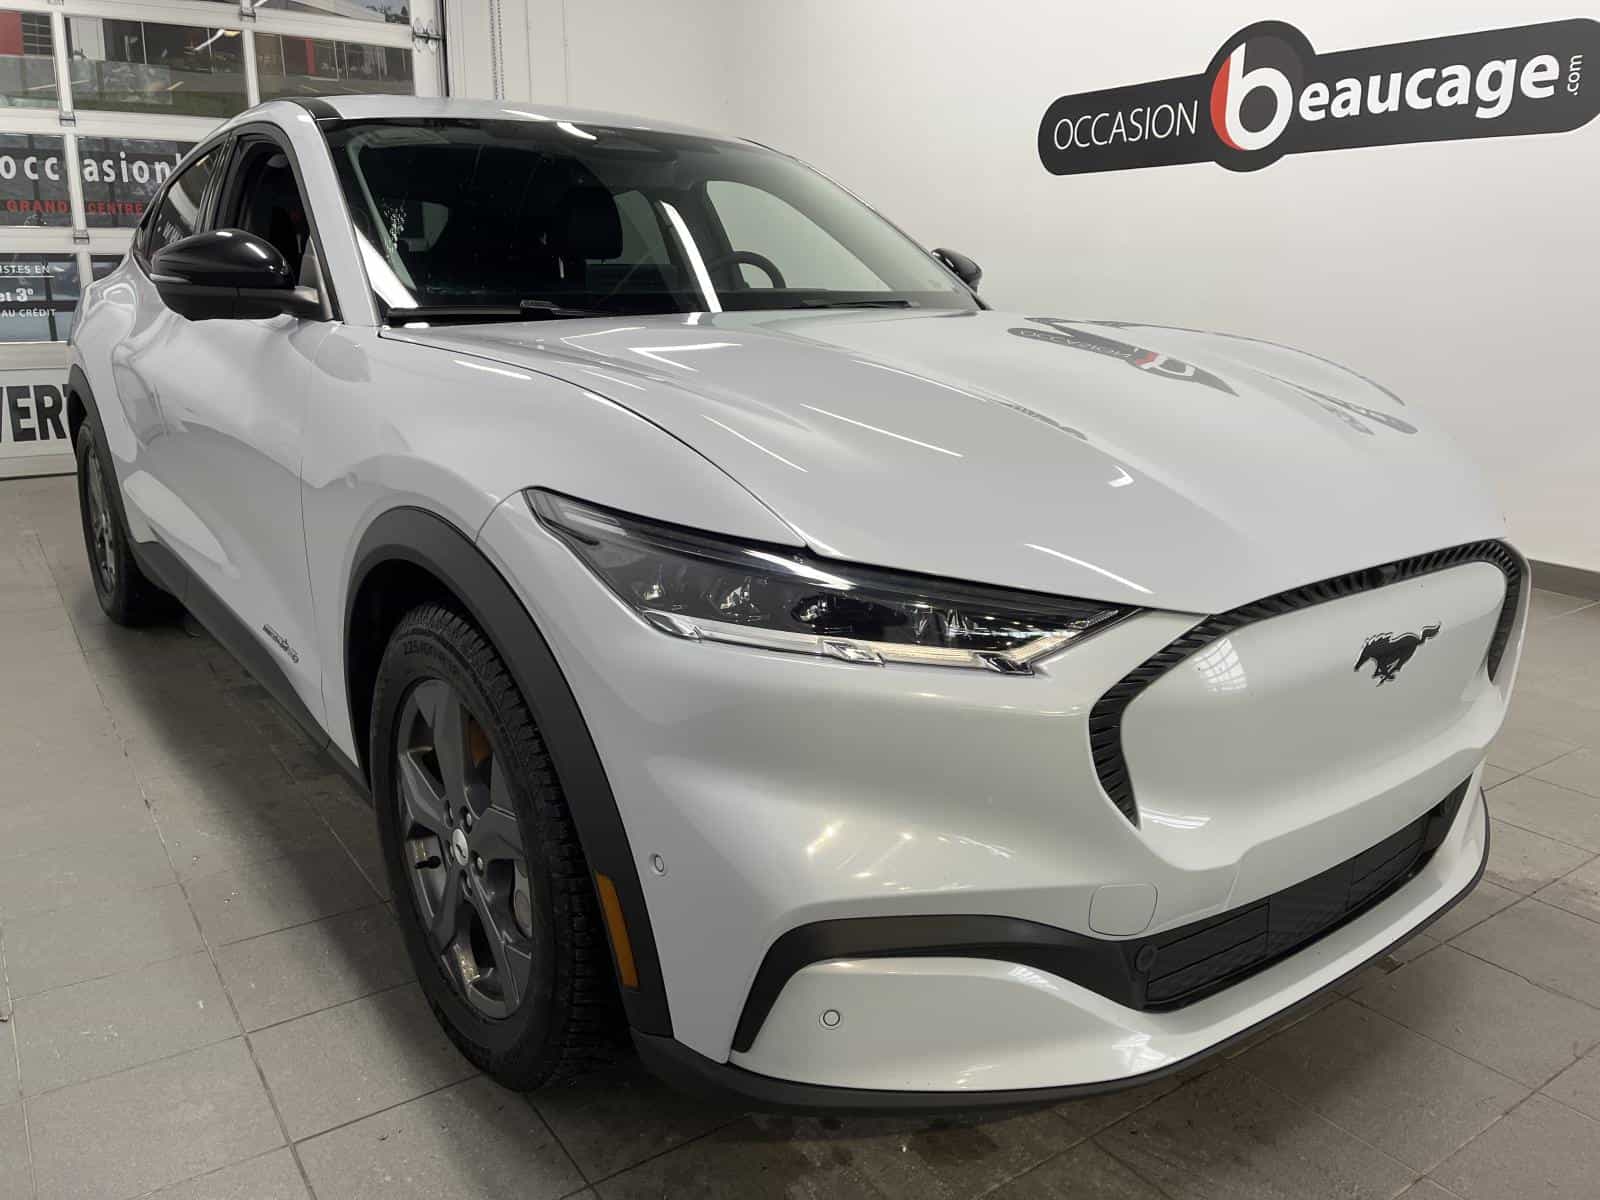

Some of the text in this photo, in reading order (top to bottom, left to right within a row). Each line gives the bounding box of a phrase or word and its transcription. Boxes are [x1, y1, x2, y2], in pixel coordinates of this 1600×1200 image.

[1053, 100, 1199, 151] OCCASION
[5, 199, 144, 217] GRAND CENTRE
[34, 265, 50, 274] EN
[1, 307, 57, 318] AU CRÉDIT
